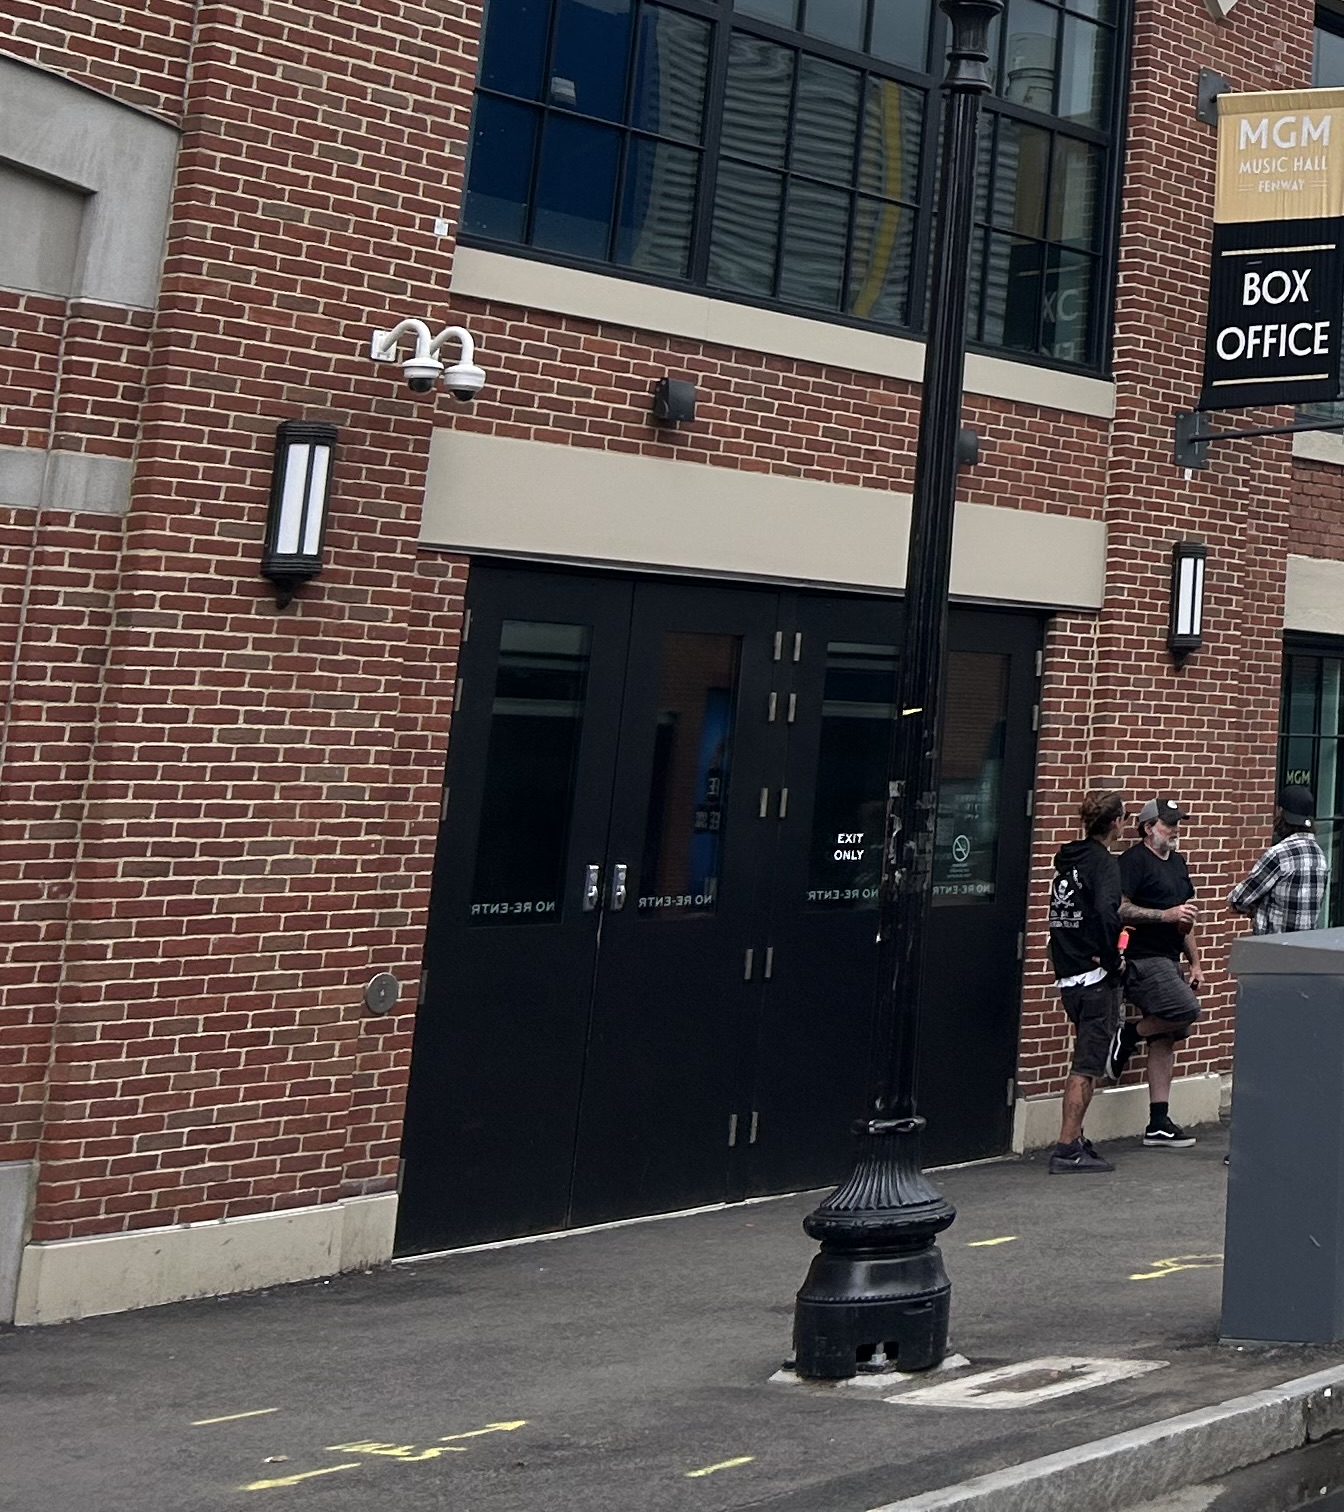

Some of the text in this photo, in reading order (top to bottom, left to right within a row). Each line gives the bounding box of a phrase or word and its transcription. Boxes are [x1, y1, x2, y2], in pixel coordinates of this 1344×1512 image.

[1239, 115, 1331, 150] MGM
[1239, 155, 1328, 174] MUSIC HALL
[1258, 178, 1305, 192] FENWAY
[1242, 269, 1311, 306] BOX
[1216, 321, 1330, 360] OFFICE
[1286, 770, 1310, 784] MGM
[837, 833, 864, 844] EXIT
[834, 850, 864, 861] ONLY
